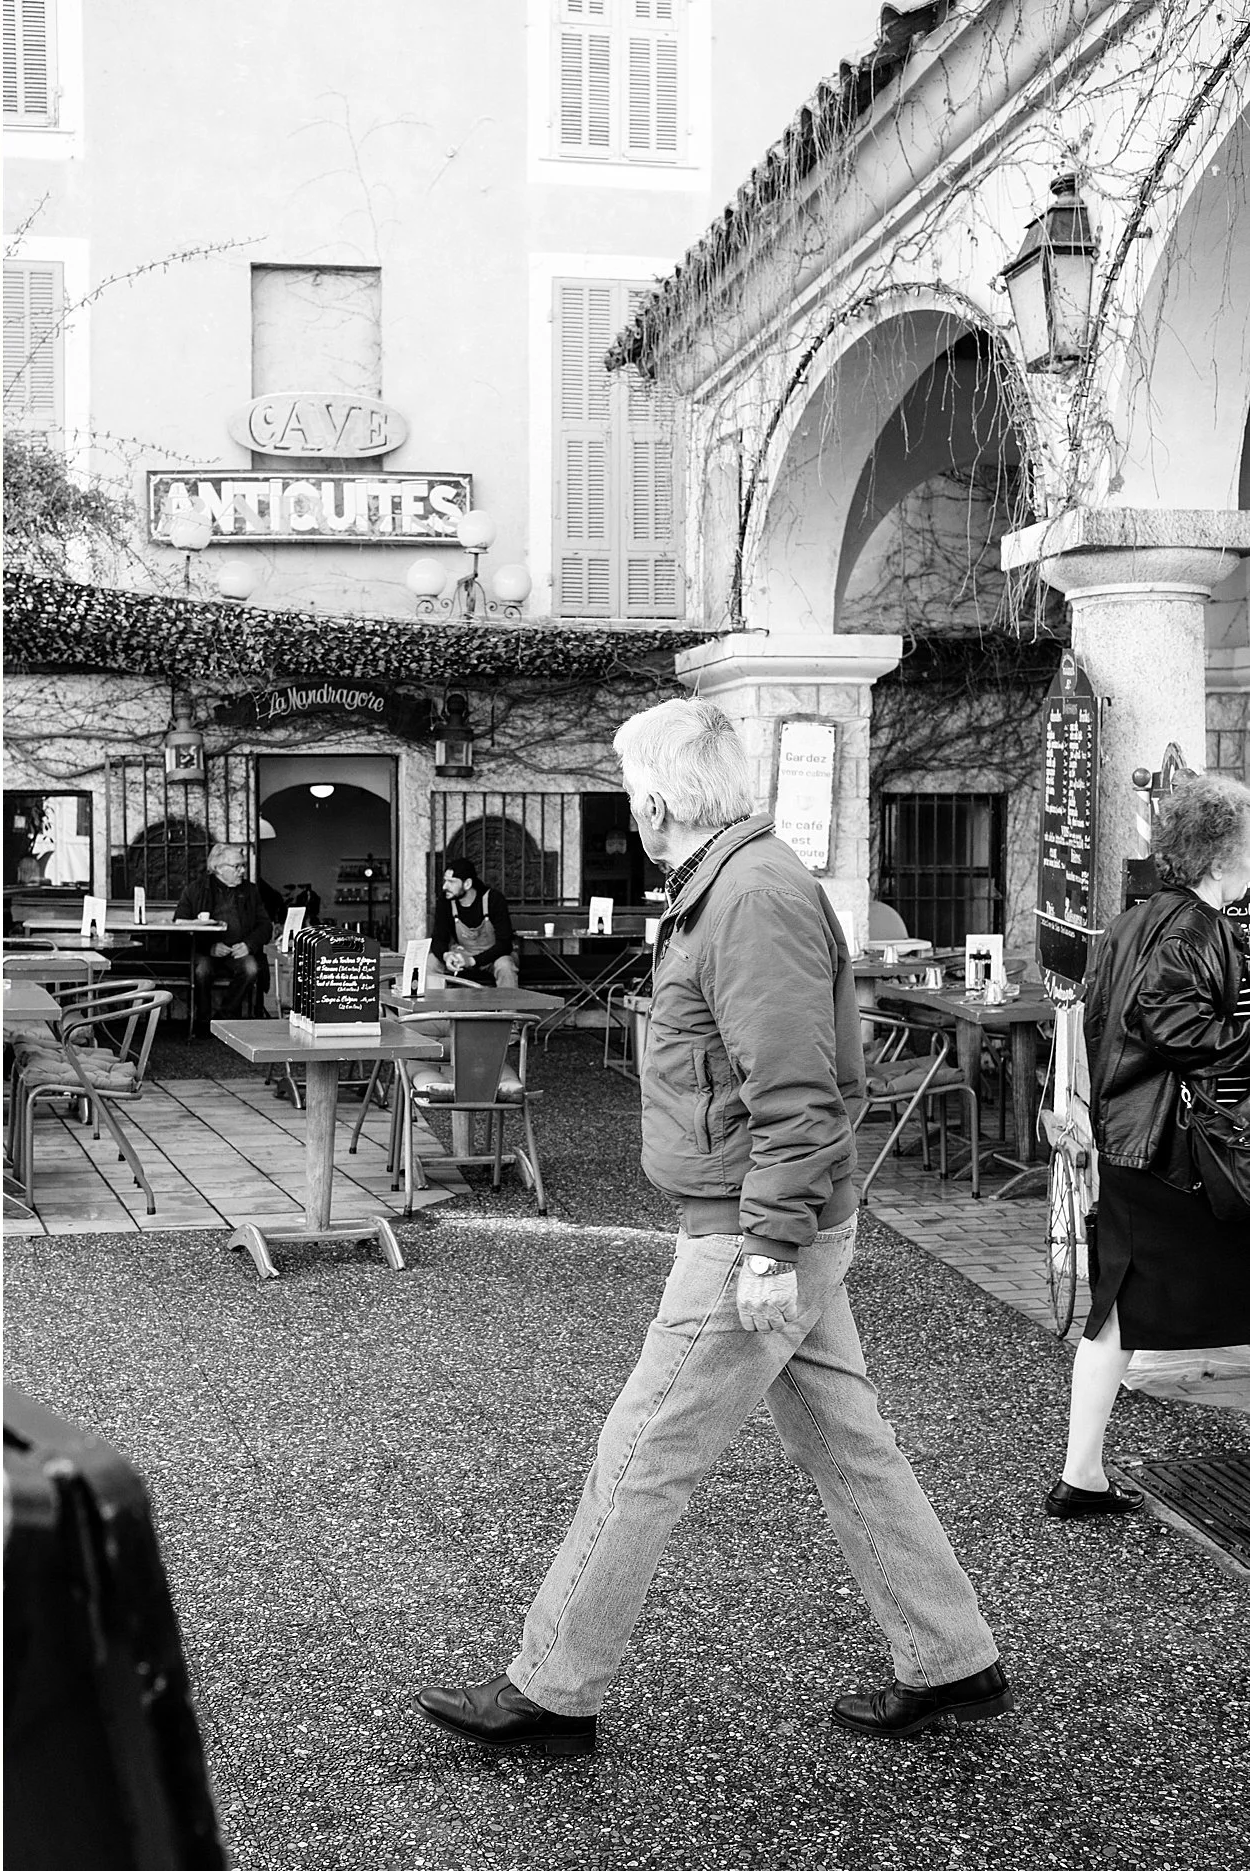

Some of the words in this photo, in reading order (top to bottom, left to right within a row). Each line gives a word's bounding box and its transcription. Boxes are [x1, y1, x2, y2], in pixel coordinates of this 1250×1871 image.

[249, 399, 388, 452] CAVE
[268, 692, 286, 718] La
[282, 683, 385, 715] Mandragore
[785, 751, 827, 764] Gardez
[781, 819, 792, 829] le
[796, 820, 823, 831] café
[791, 837, 811, 845] est
